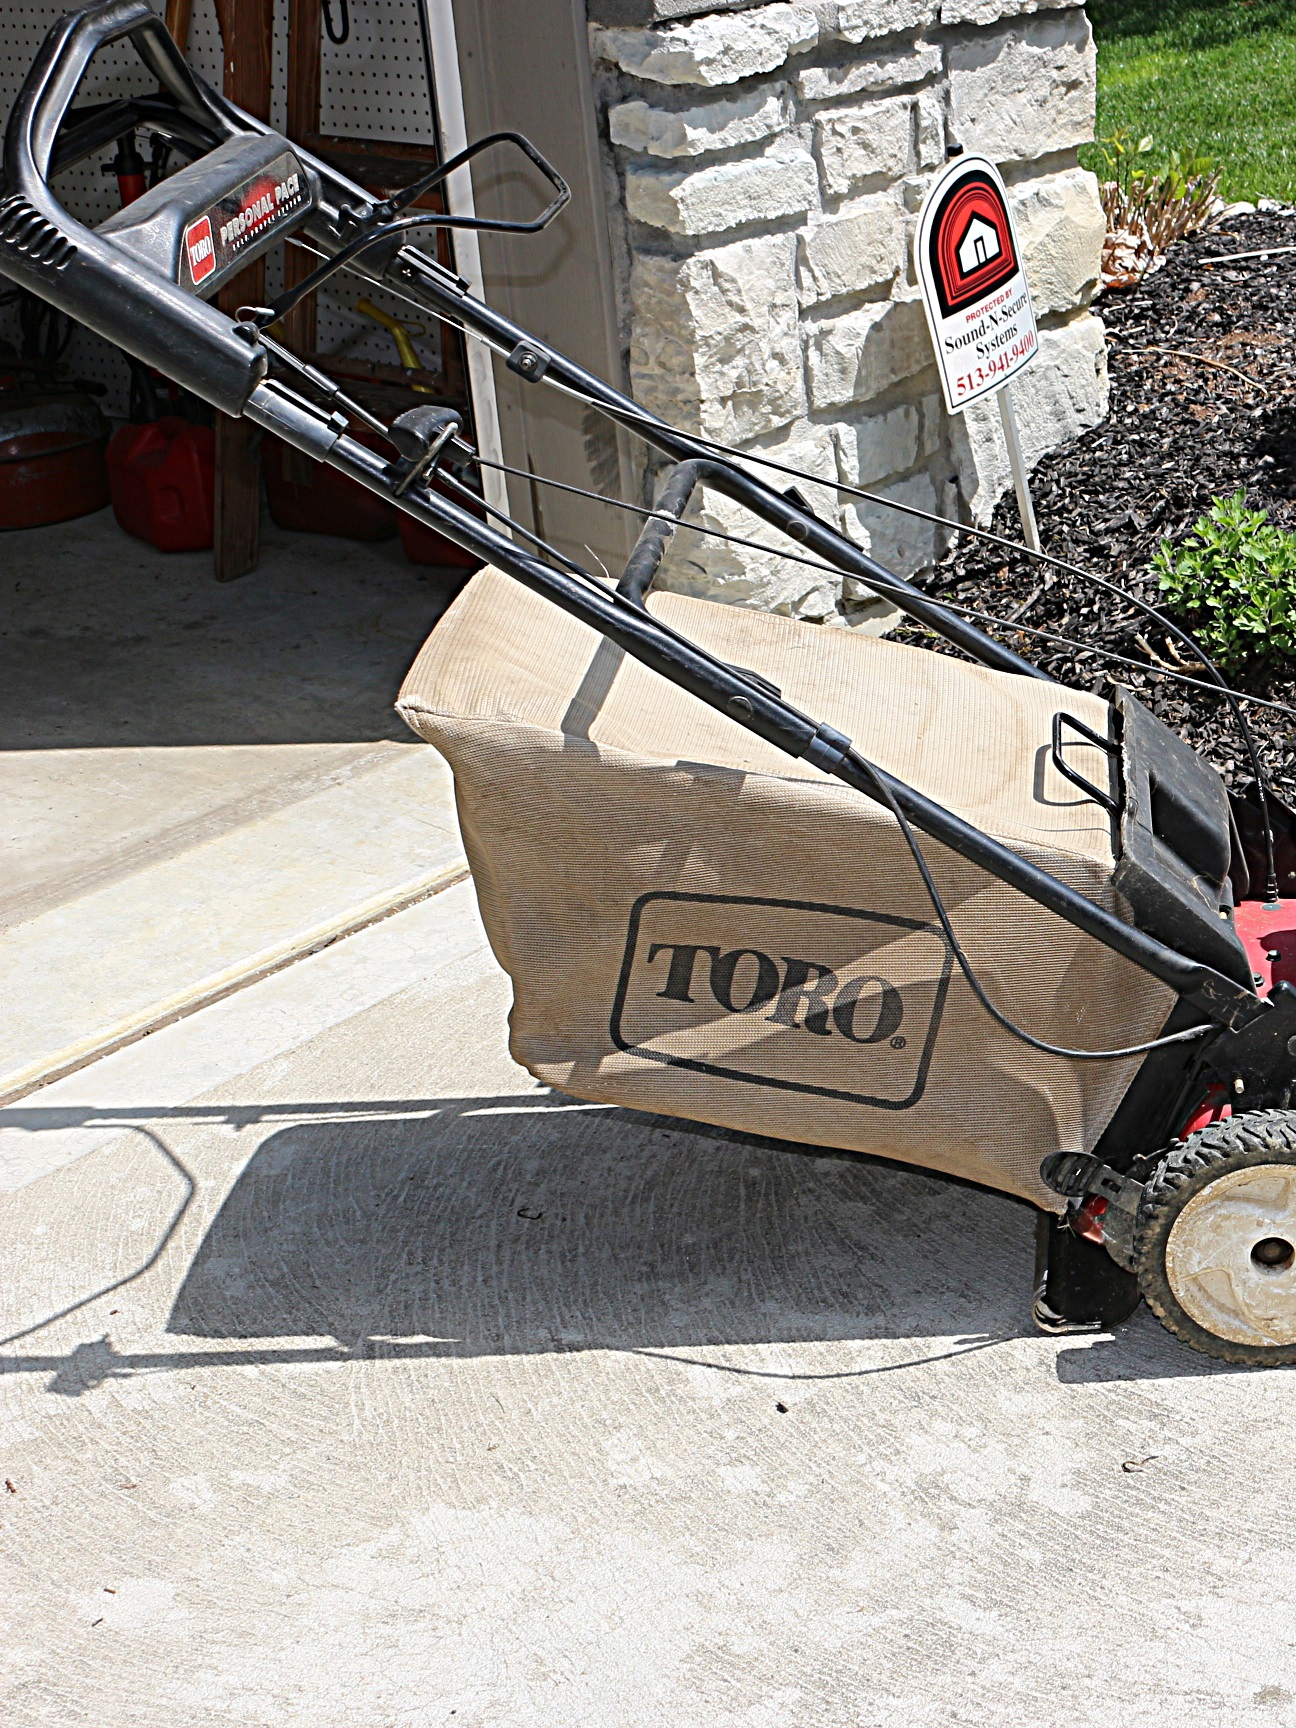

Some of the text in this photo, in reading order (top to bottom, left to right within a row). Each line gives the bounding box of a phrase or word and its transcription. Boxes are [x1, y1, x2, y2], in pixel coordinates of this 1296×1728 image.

[219, 172, 300, 247] PERSONAL PACE
[190, 235, 212, 267] TORO
[944, 291, 1028, 355] Sound-N-Secure
[965, 287, 1013, 324] PROTECTED BY
[956, 329, 1035, 397] 513-941-9400
[975, 323, 1018, 360] Systems
[647, 942, 904, 1044] TORO
